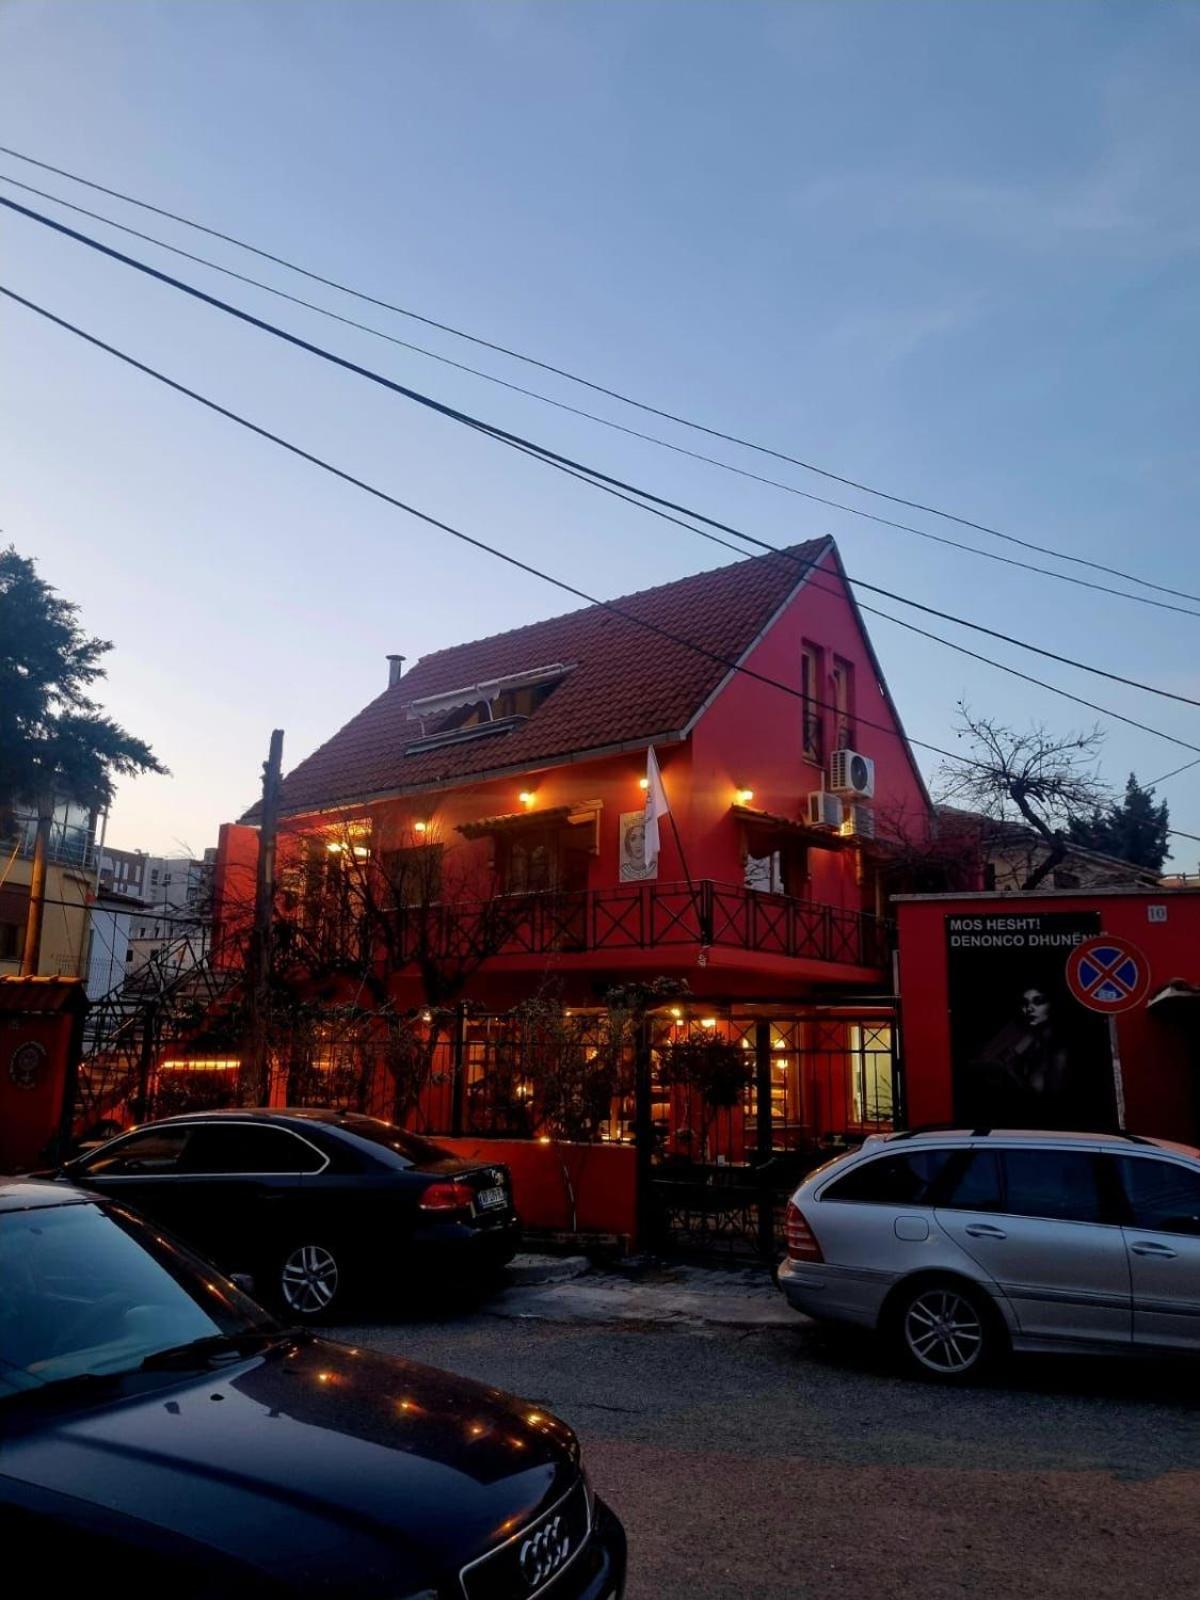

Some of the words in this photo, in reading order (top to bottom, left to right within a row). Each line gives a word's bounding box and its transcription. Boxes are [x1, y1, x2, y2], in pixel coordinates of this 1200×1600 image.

[950, 919, 983, 930] MOS
[986, 918, 1040, 930] HESHT!
[950, 935, 1025, 947] DENONCO
